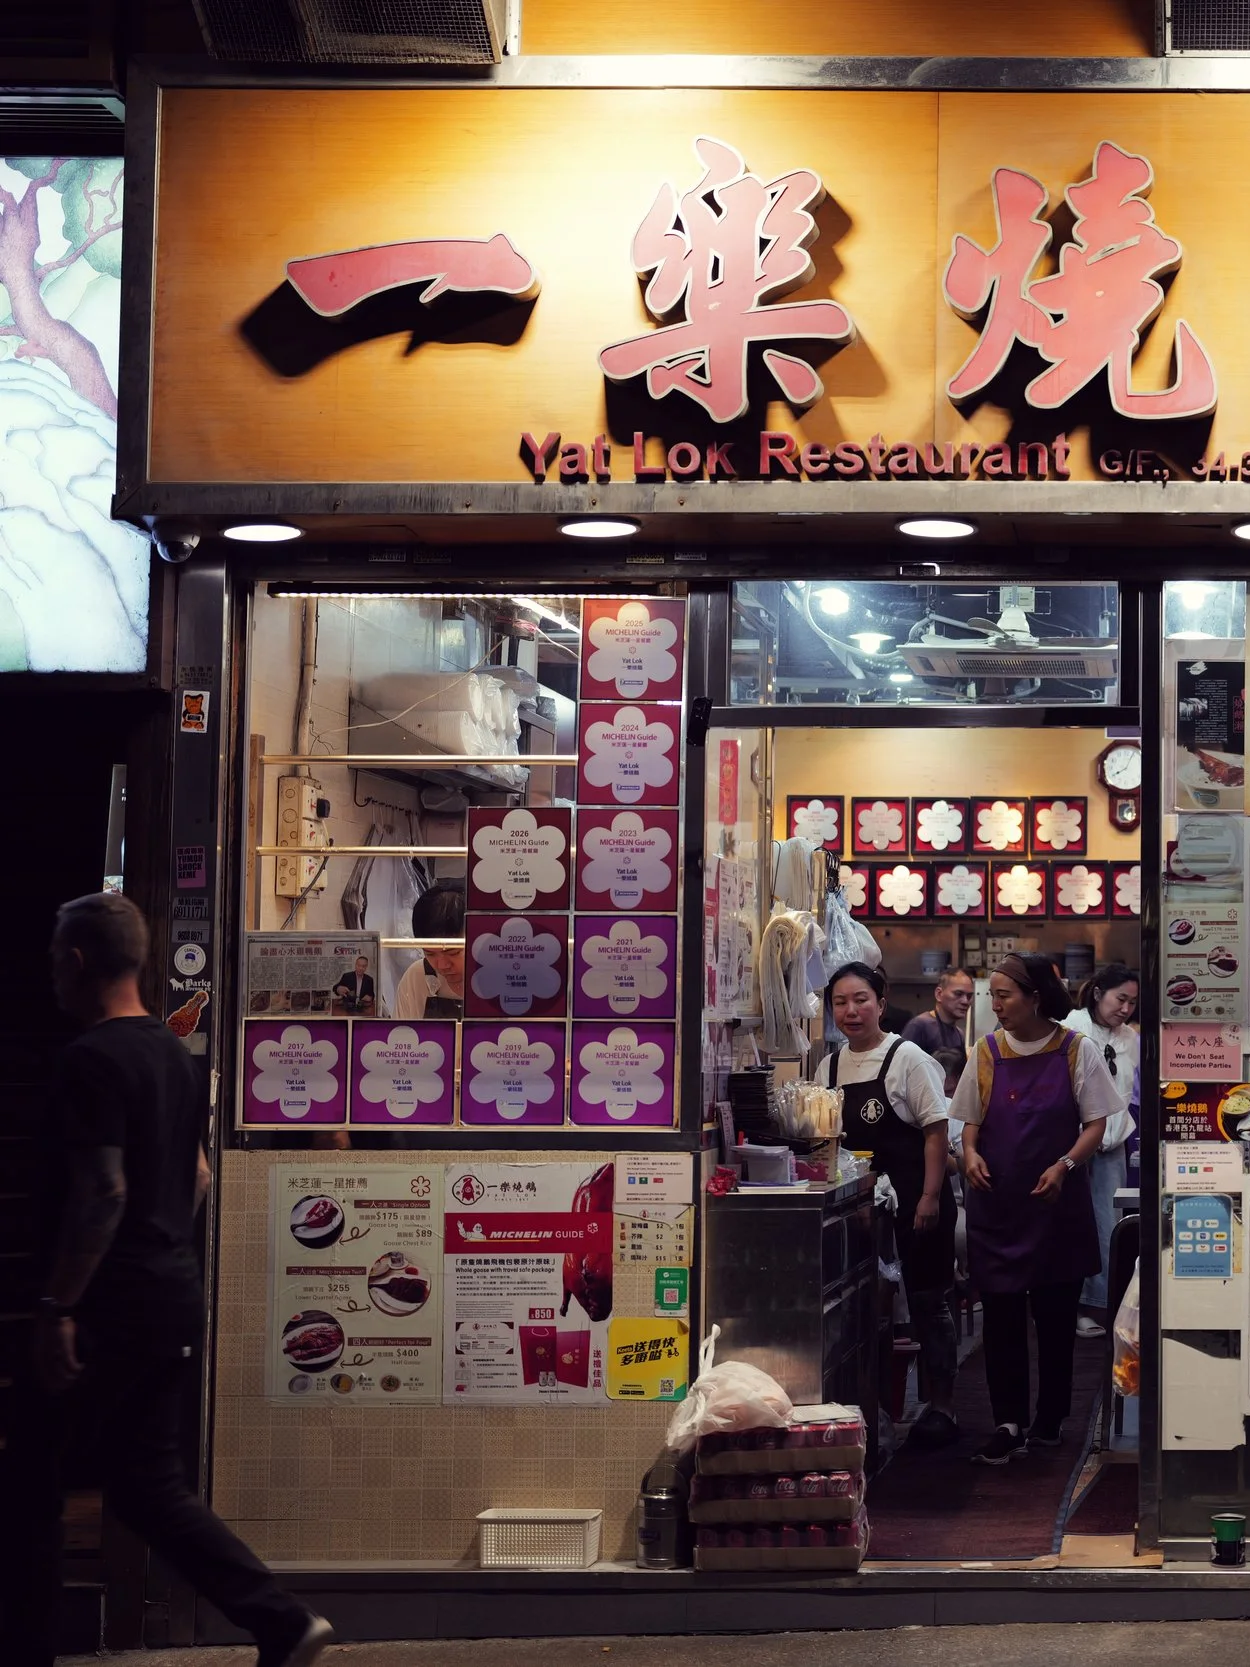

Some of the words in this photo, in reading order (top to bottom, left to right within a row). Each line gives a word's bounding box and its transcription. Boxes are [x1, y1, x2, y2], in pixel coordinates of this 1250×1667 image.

[520, 431, 610, 476] Yat
[633, 431, 737, 476] Lok
[759, 431, 1070, 477] Restaurant
[600, 838, 634, 846] MICHELIN
[598, 946, 631, 954] MICHELIN
[631, 946, 652, 954] Guide
[1173, 1036, 1225, 1048] 人齊入座
[1165, 1102, 1208, 1114] 一樂燒鵝
[287, 1177, 368, 1189] 米芝蓮一星推薦
[376, 1211, 399, 1220] $175
[415, 1229, 432, 1238] $89
[489, 1231, 553, 1239] MICHELIN
[555, 1231, 584, 1239] GUIDE
[327, 1283, 350, 1293] $255
[396, 1349, 419, 1357] $400
